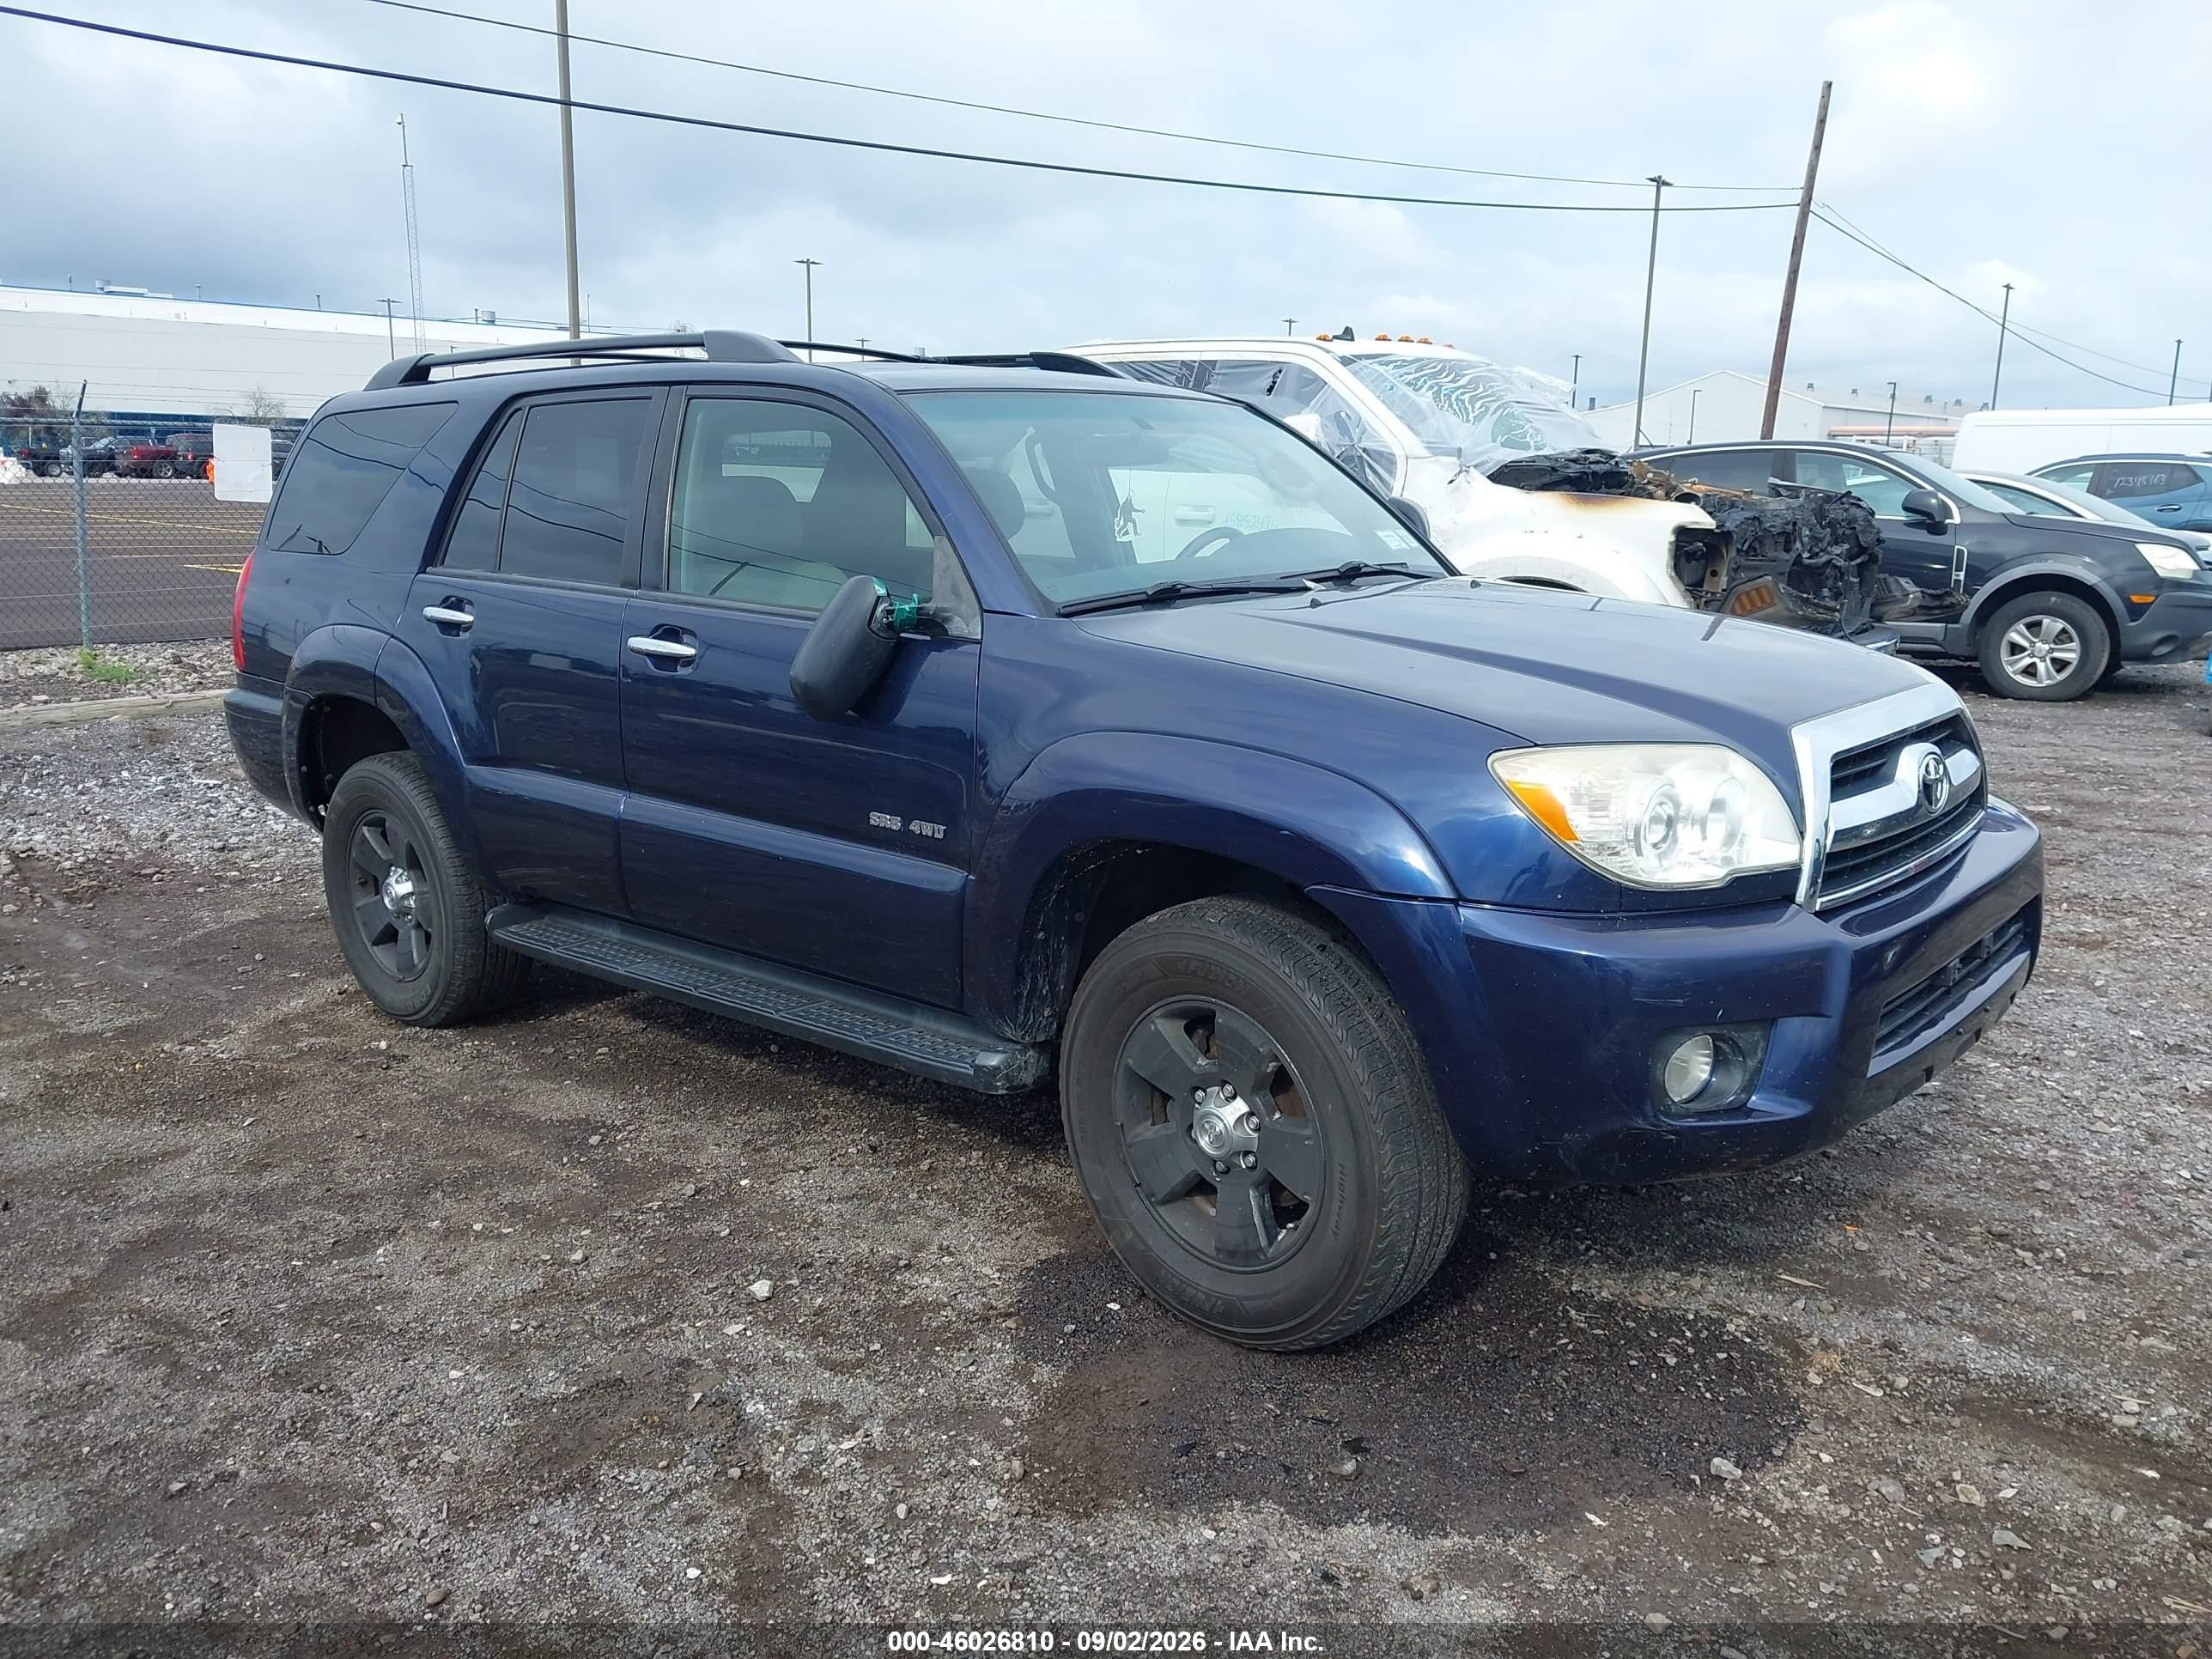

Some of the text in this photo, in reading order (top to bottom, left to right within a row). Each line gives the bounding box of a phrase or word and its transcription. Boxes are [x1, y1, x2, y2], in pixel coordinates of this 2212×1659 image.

[869, 811, 946, 839] SR5 4WD
[1332, 1162, 1346, 1243] Highway
